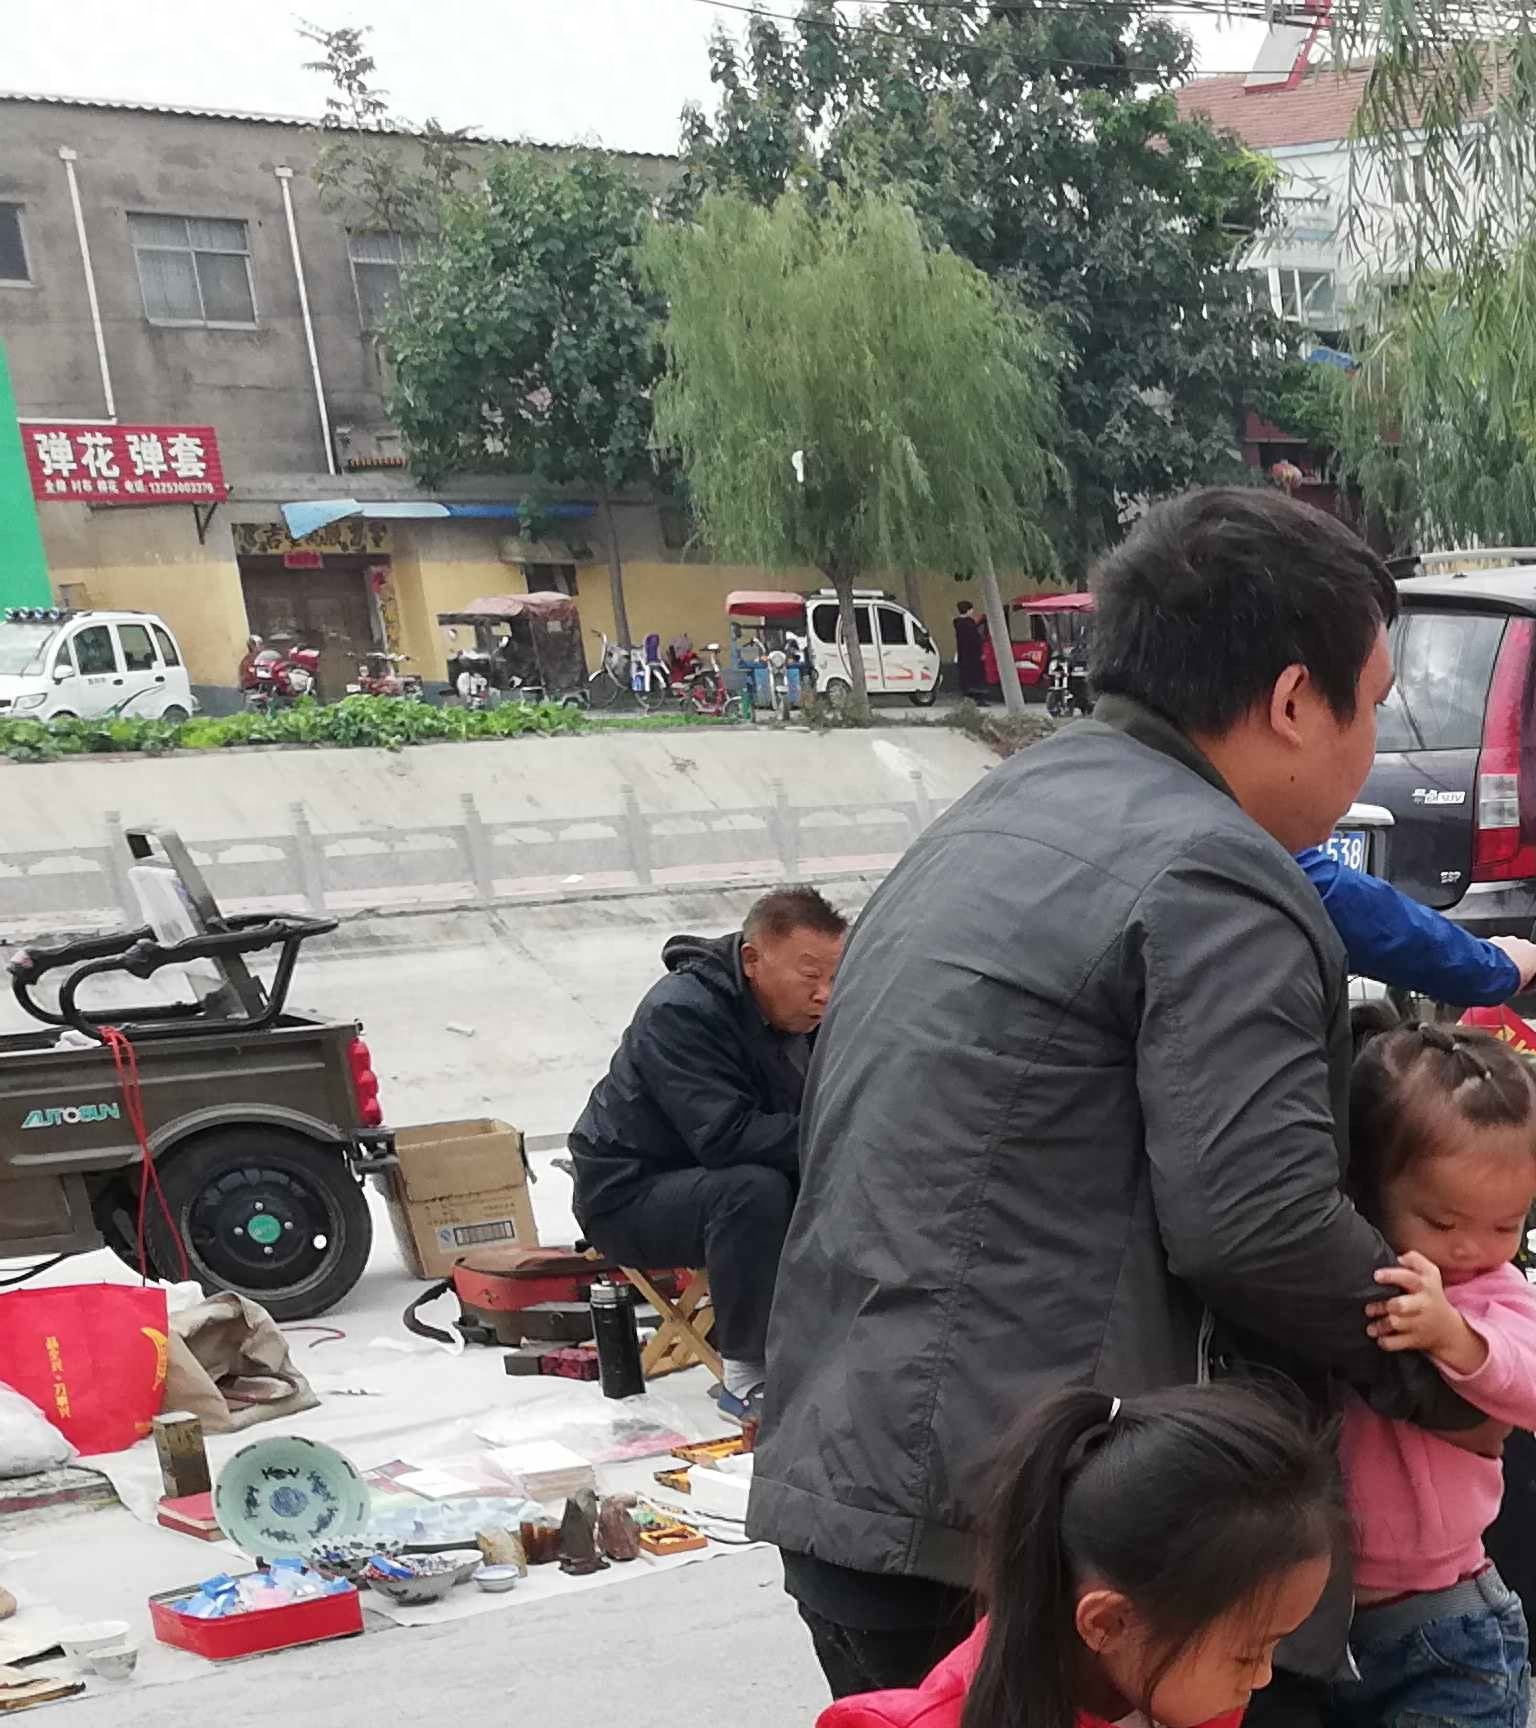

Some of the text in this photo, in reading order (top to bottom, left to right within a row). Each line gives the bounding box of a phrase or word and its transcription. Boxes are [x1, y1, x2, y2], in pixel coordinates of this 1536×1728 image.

[33, 431, 206, 479] 弹花 弹套
[1318, 838, 1361, 869] 538
[21, 1102, 120, 1129] AUTOSUN
